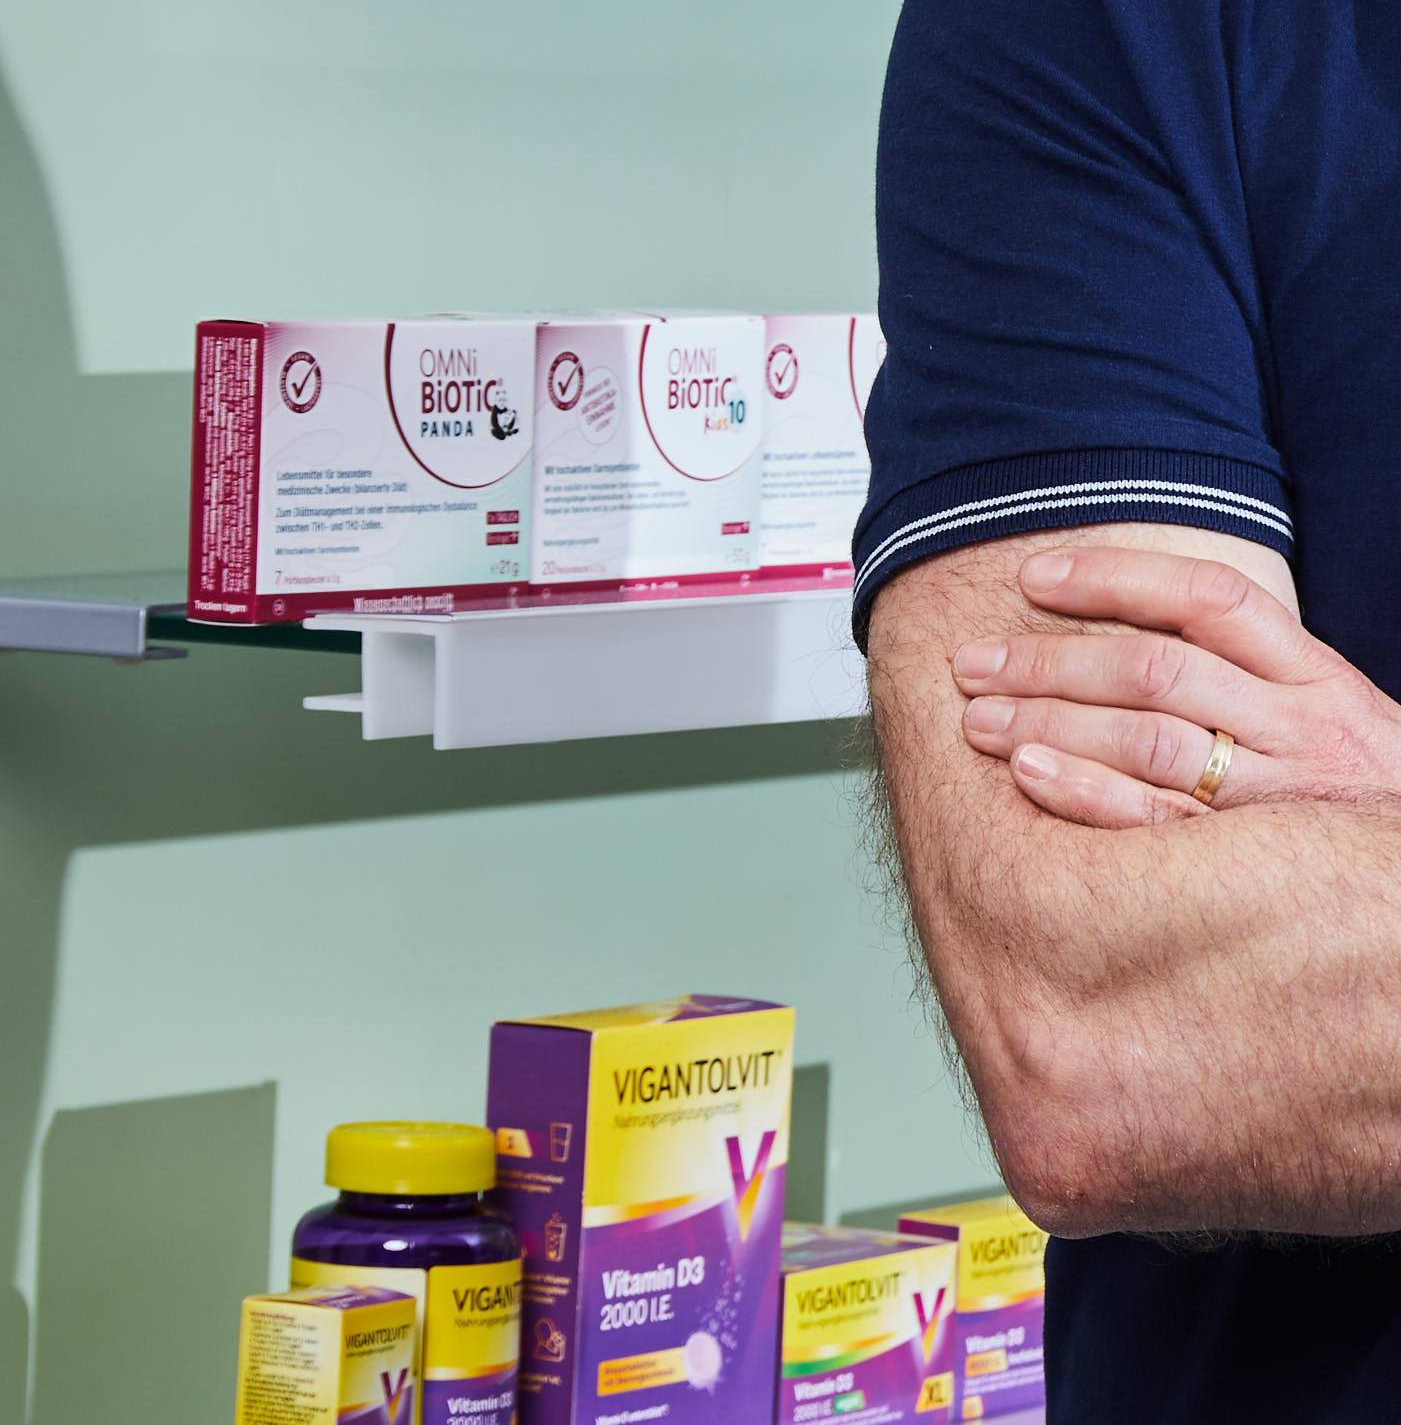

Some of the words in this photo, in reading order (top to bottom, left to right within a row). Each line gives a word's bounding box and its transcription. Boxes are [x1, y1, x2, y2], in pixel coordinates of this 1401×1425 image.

[421, 379, 497, 415] BiOTiC
[668, 377, 732, 410] BiOTiC
[729, 399, 746, 424] 10
[421, 421, 474, 438] PANDA
[276, 470, 323, 481] Lebensmittel
[324, 470, 334, 480] für
[336, 469, 373, 479] besondere
[276, 485, 322, 496] medizinische
[324, 485, 351, 494] Zwecke
[276, 508, 291, 518] Zum
[293, 506, 353, 519] Diätmanagement
[354, 505, 365, 515] bei
[366, 505, 384, 515] einer
[275, 522, 309, 533] zwischen
[329, 521, 343, 531] und
[194, 599, 222, 611] Trocken
[223, 602, 248, 615] lagern
[613, 1050, 774, 1106] VIGANTOLVIT
[613, 1101, 742, 1129] Nahrungsergänzungsmittel
[602, 1264, 675, 1300] Vitamin
[677, 1256, 705, 1287] D3
[796, 1271, 900, 1314] VIGANTOLVIT
[600, 1300, 647, 1331] 2000
[650, 1293, 674, 1321] I.E.
[345, 1324, 410, 1350] VIGANTOLVIT
[966, 1332, 1006, 1355] Vitamin
[793, 1377, 834, 1401] Vitamin
[926, 1381, 944, 1407] XL
[447, 1397, 499, 1415] Vitamin
